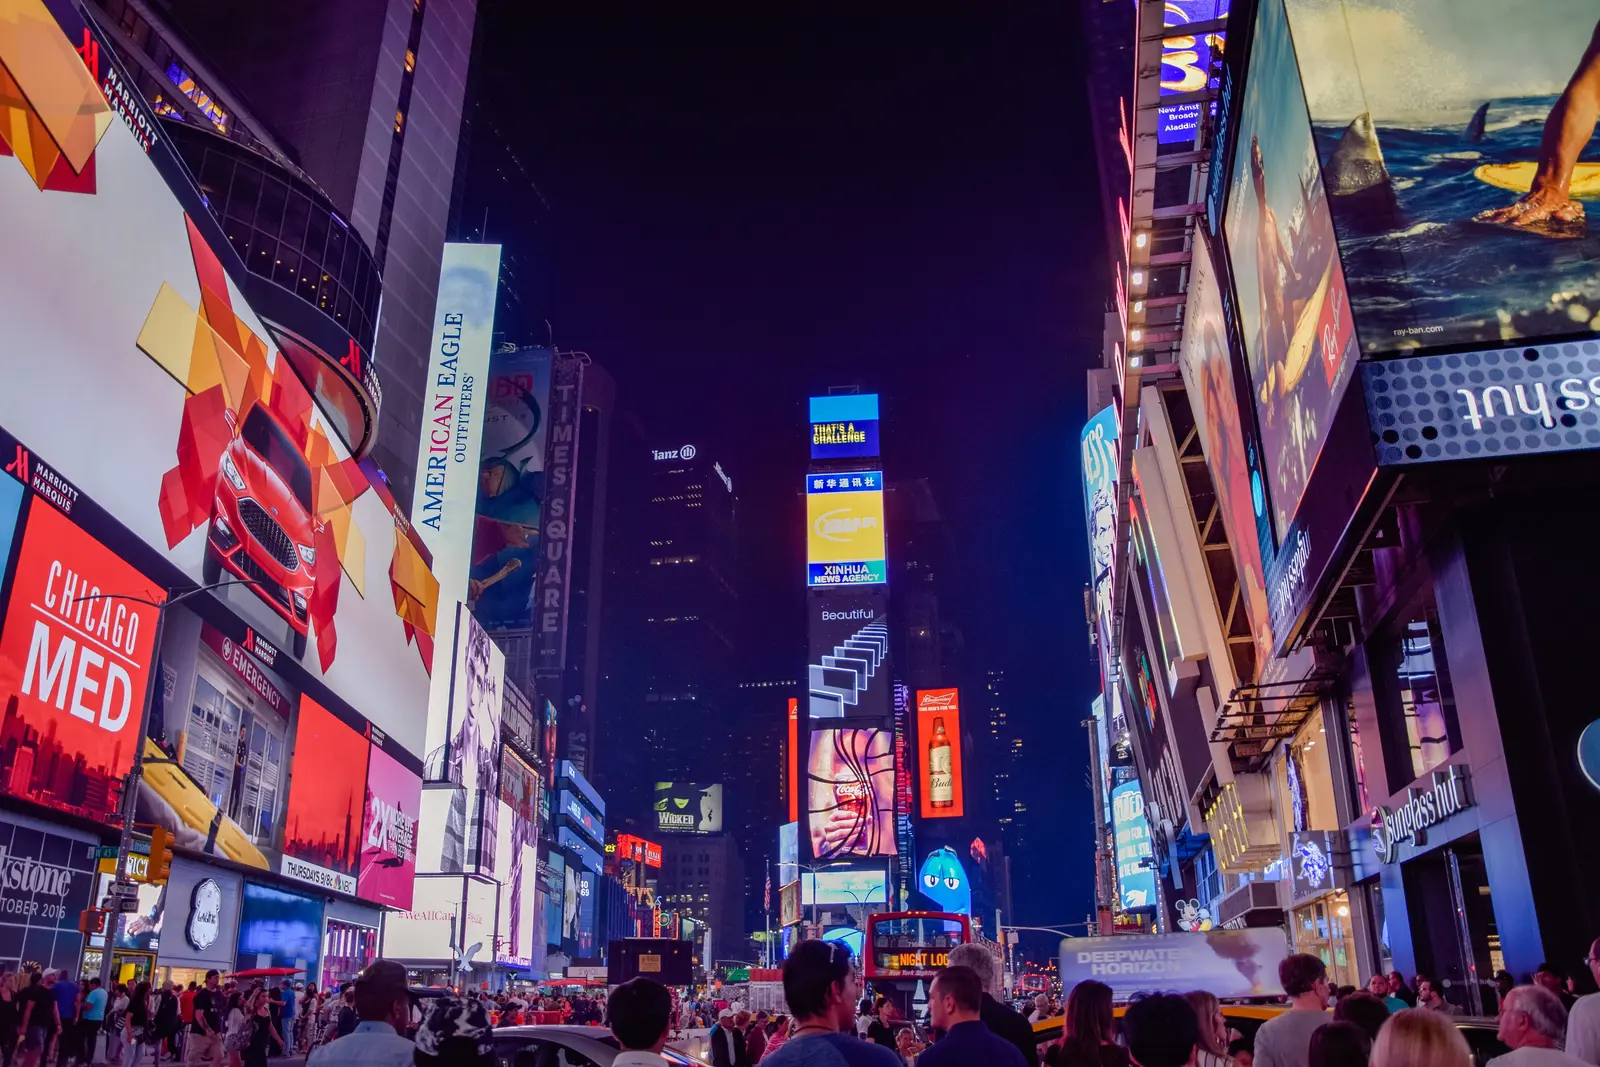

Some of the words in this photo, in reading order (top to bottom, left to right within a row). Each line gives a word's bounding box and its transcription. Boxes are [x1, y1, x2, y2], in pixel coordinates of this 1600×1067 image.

[107, 67, 158, 146] MARRIOTT
[1158, 107, 1176, 115] New
[1393, 325, 1444, 337] ray-ban.com
[437, 312, 464, 388] EAGLE
[1456, 382, 1554, 430] hut
[552, 384, 576, 486] TIMES
[812, 423, 846, 436] THAT'S
[847, 421, 855, 434] A
[812, 431, 866, 445] CHALLENGE
[421, 393, 455, 532] AMERICAN
[652, 450, 679, 461] ianz
[36, 463, 78, 502] MARRIOTT
[813, 477, 876, 490] 新华通讯社
[33, 476, 71, 512] MARQUIS
[542, 499, 568, 633] SQUARE
[824, 564, 870, 576] XINHUA
[814, 574, 841, 584] NEWS
[841, 573, 880, 583] AGENCY
[44, 560, 140, 655] CHICAGO
[821, 608, 874, 621] Beautiful
[255, 635, 278, 657] MARRIOTT
[20, 619, 132, 732] MED
[232, 648, 281, 709] EMERGENCY
[1386, 788, 1436, 847] sunglass
[1432, 764, 1462, 818] hut
[368, 796, 390, 851] 2X
[103, 848, 112, 858] 45
[287, 861, 321, 883] THURSDAYS
[320, 873, 333, 887] 9/8c
[342, 880, 353, 893] NBC
[41, 903, 66, 919] 2016
[900, 953, 927, 966] NIGHT
[1077, 947, 1192, 964] DEEPWATER
[1091, 960, 1181, 976] HORIZON
